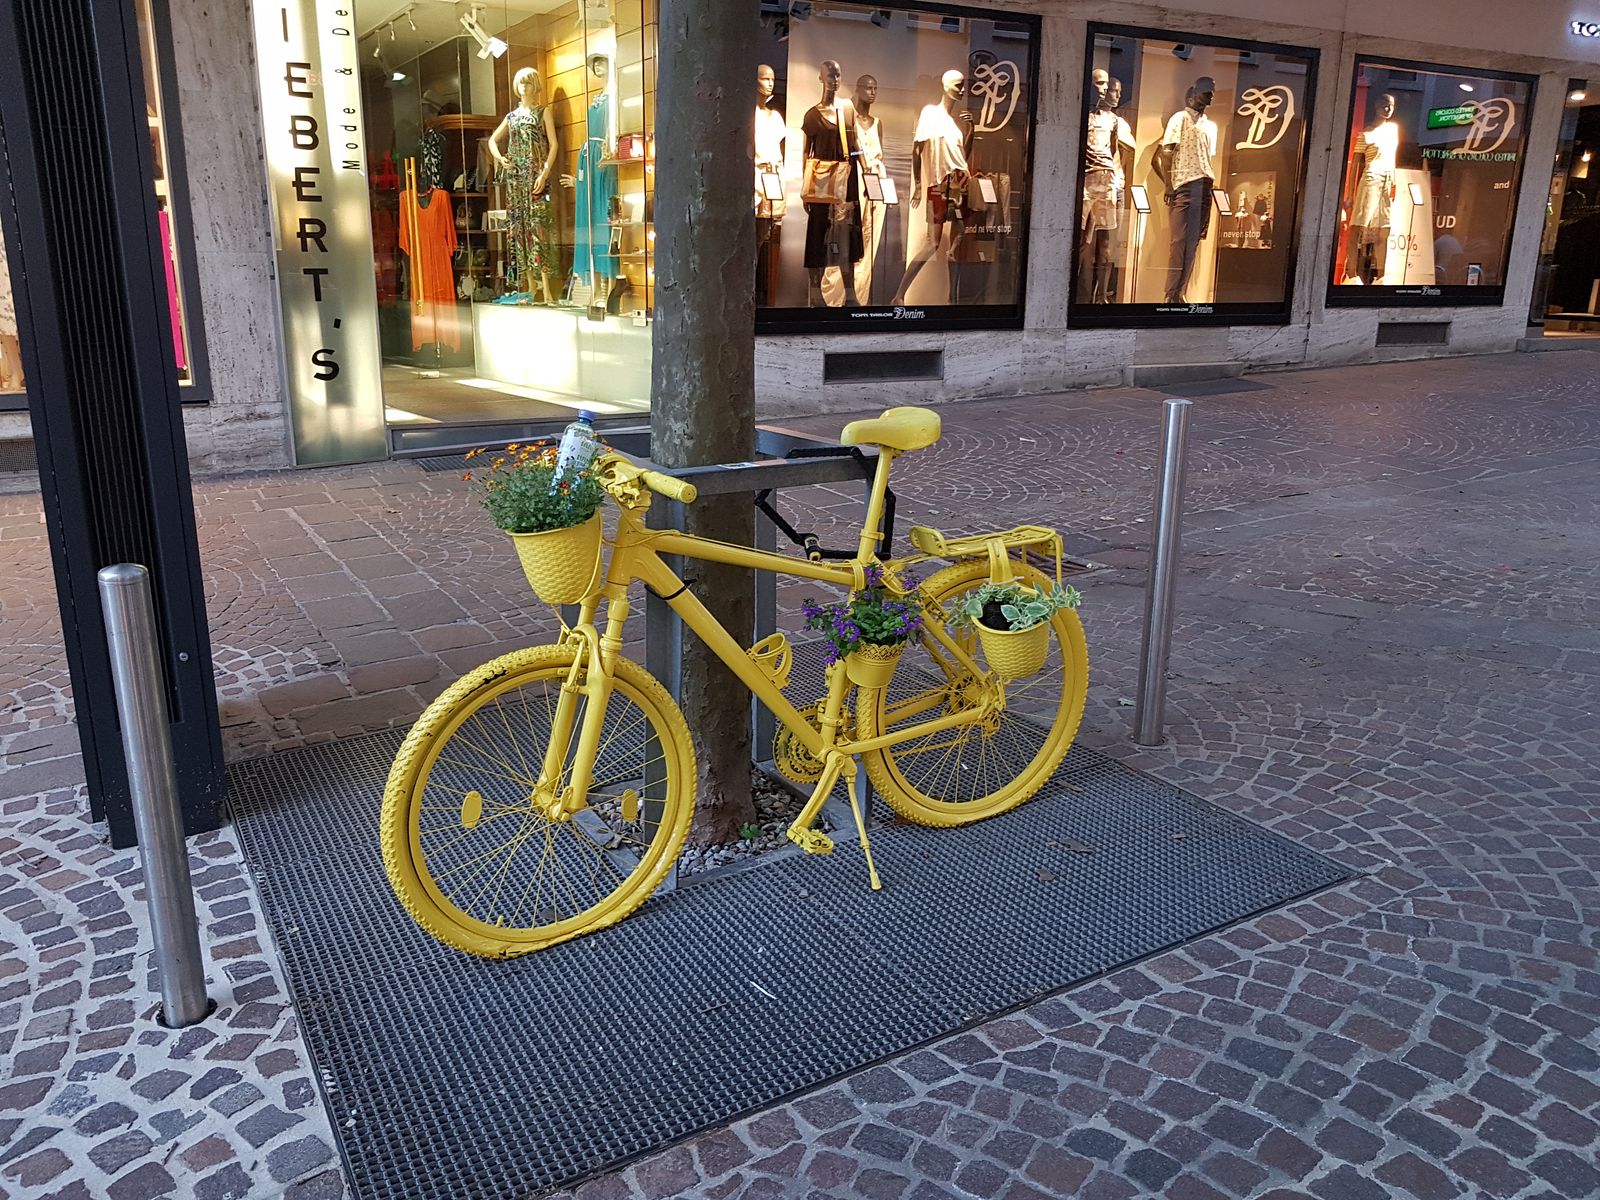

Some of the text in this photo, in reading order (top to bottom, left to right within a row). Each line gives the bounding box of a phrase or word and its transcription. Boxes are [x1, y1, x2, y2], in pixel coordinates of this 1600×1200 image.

[334, 67, 353, 76] &
[340, 107, 361, 170] Mode
[1494, 180, 1510, 189] and
[997, 224, 1012, 235] stop
[1244, 230, 1261, 240] stop
[893, 306, 925, 320] Denim
